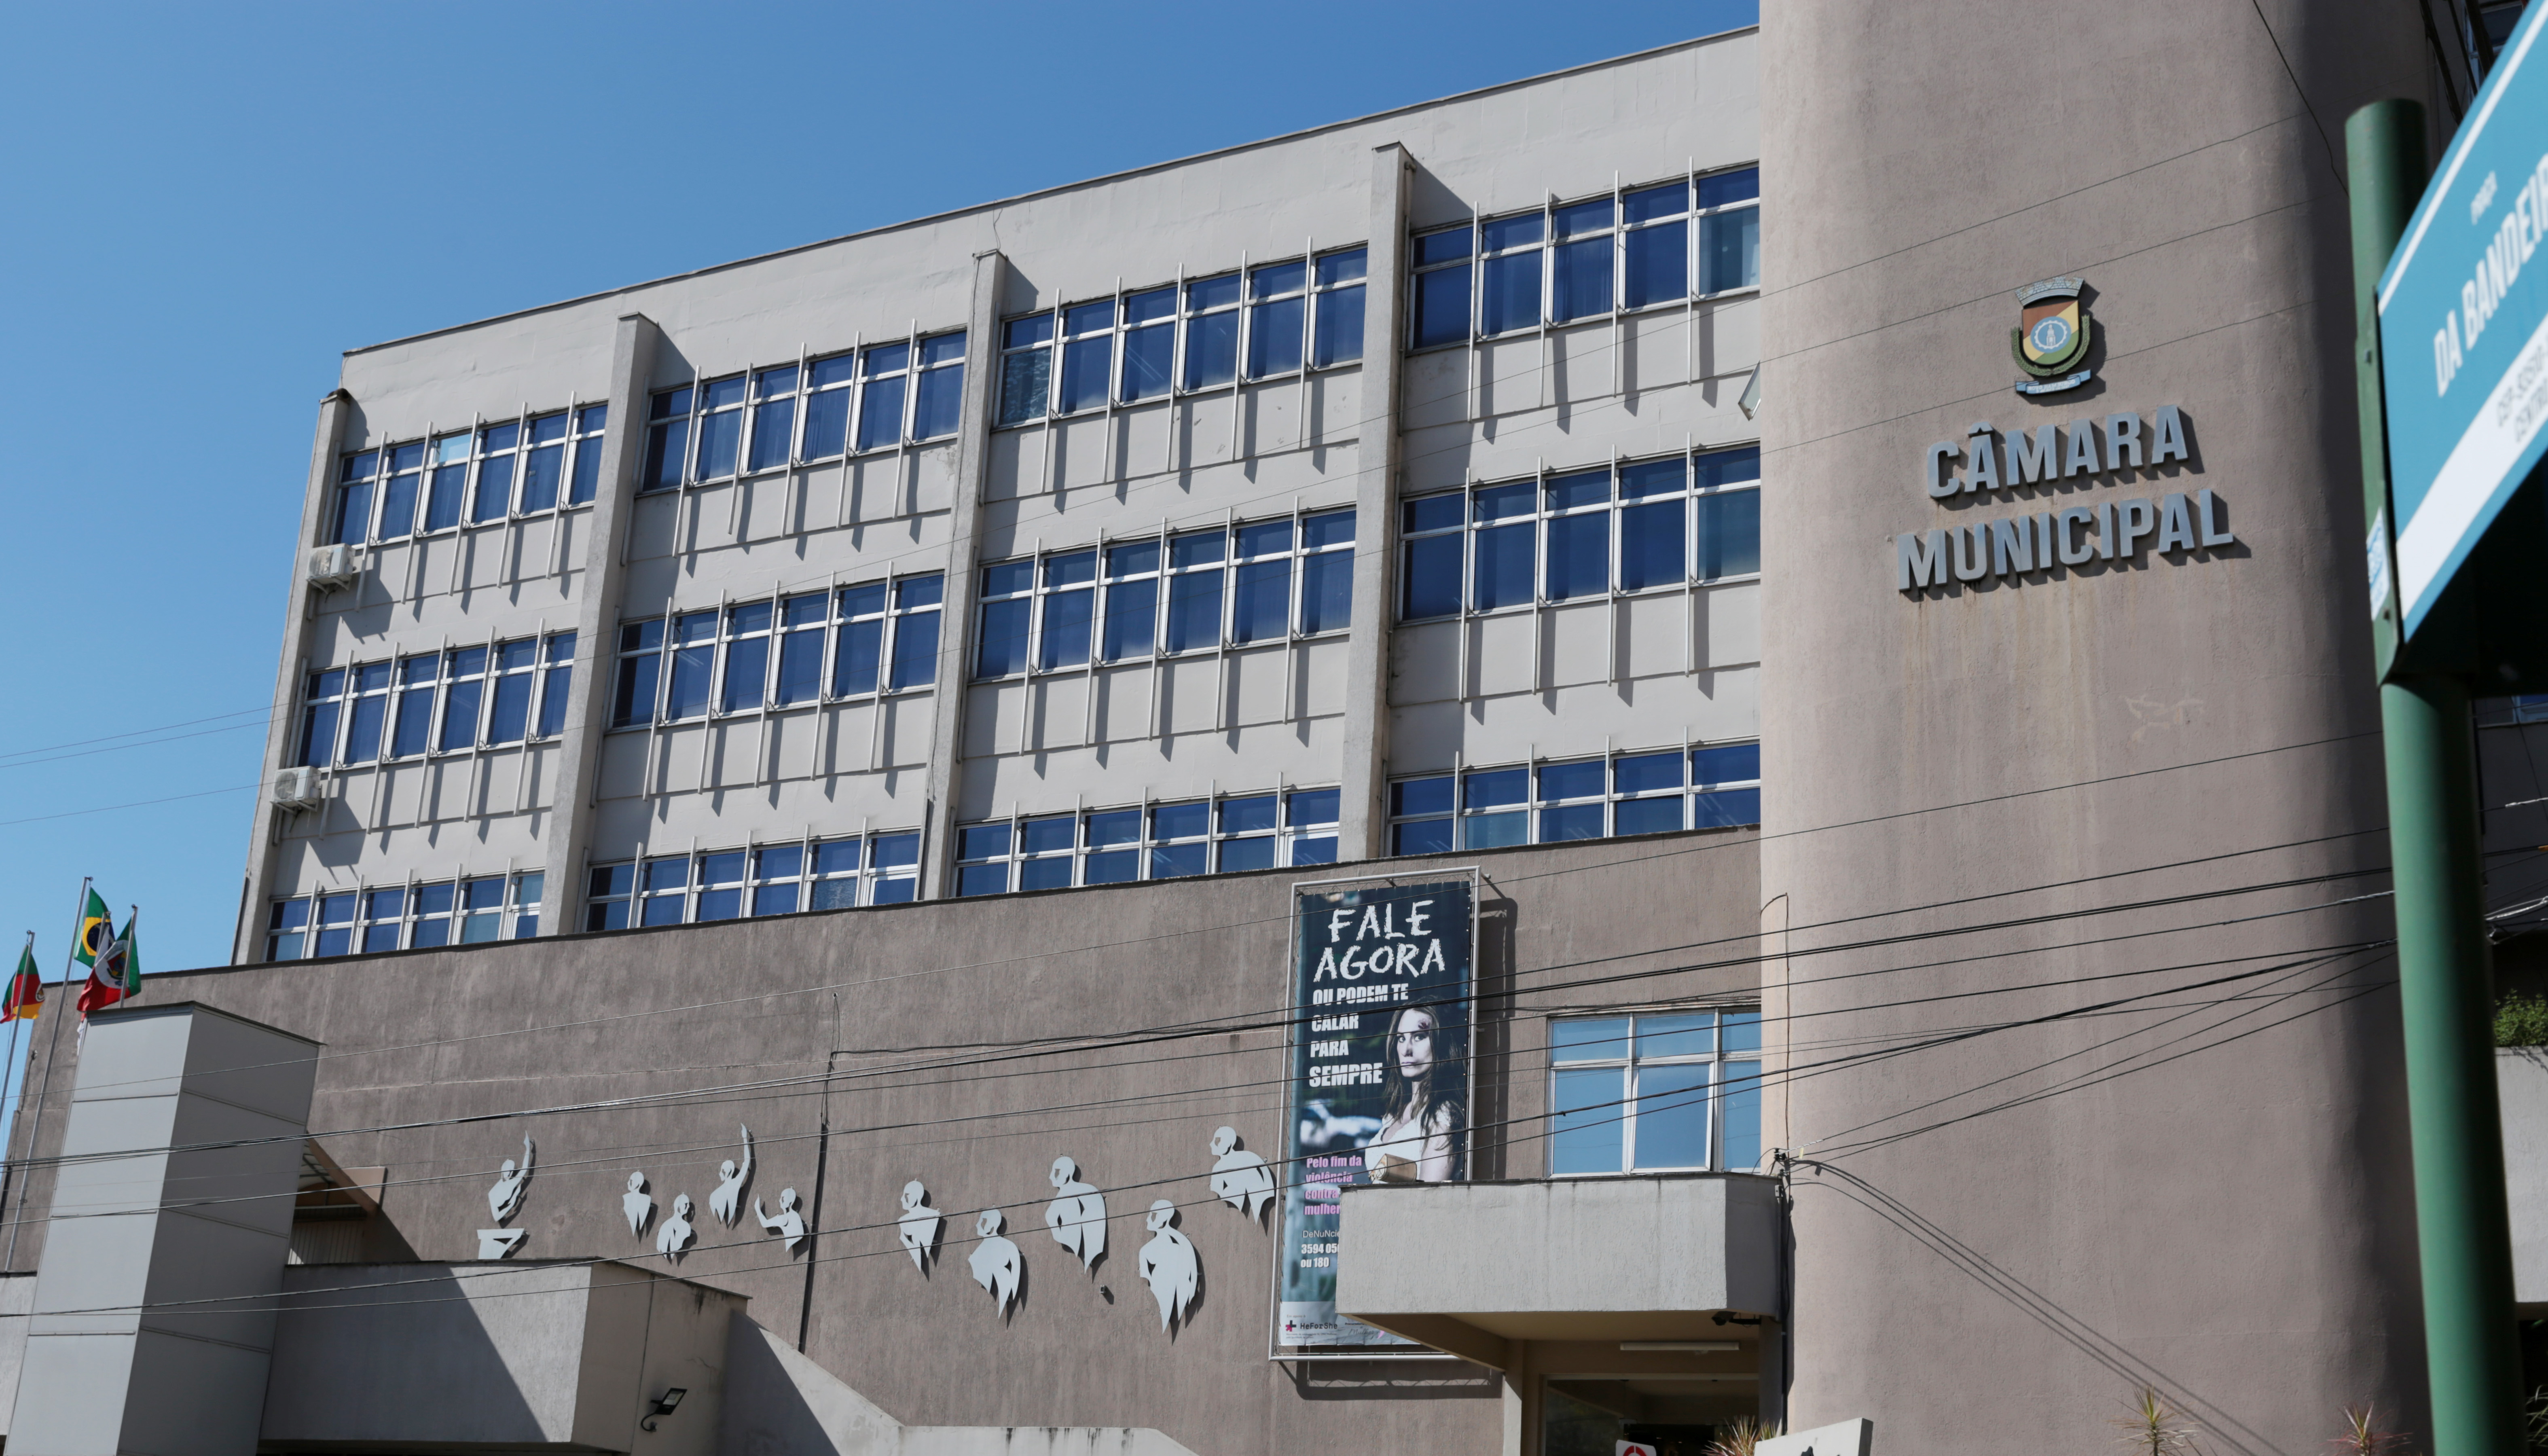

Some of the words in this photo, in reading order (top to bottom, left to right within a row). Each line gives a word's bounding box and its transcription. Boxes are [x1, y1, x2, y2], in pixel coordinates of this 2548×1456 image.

[2434, 309, 2463, 398] DA
[1927, 405, 2188, 499] CÂMARA
[1897, 489, 2234, 591] MUNICIPAL
[1328, 900, 1435, 942] FALE
[1313, 939, 1445, 982] AGORA
[1313, 989, 1333, 1006] OU
[1336, 984, 1388, 1005] PODEM
[1391, 983, 1408, 1001] TE
[1312, 1013, 1359, 1032] CALAR
[1310, 1040, 1349, 1057] PARA
[1309, 1062, 1383, 1087] SEMPRE
[1306, 1157, 1329, 1168] Pelo
[1331, 1156, 1347, 1167] fim
[1349, 1155, 1362, 1166] da
[1306, 1171, 1353, 1183] violência
[1305, 1189, 1338, 1199] contra
[1301, 1244, 1324, 1254] 3594
[1325, 1243, 1339, 1253] 05
[1300, 1259, 1312, 1268] ou
[1314, 1257, 1329, 1268] 180
